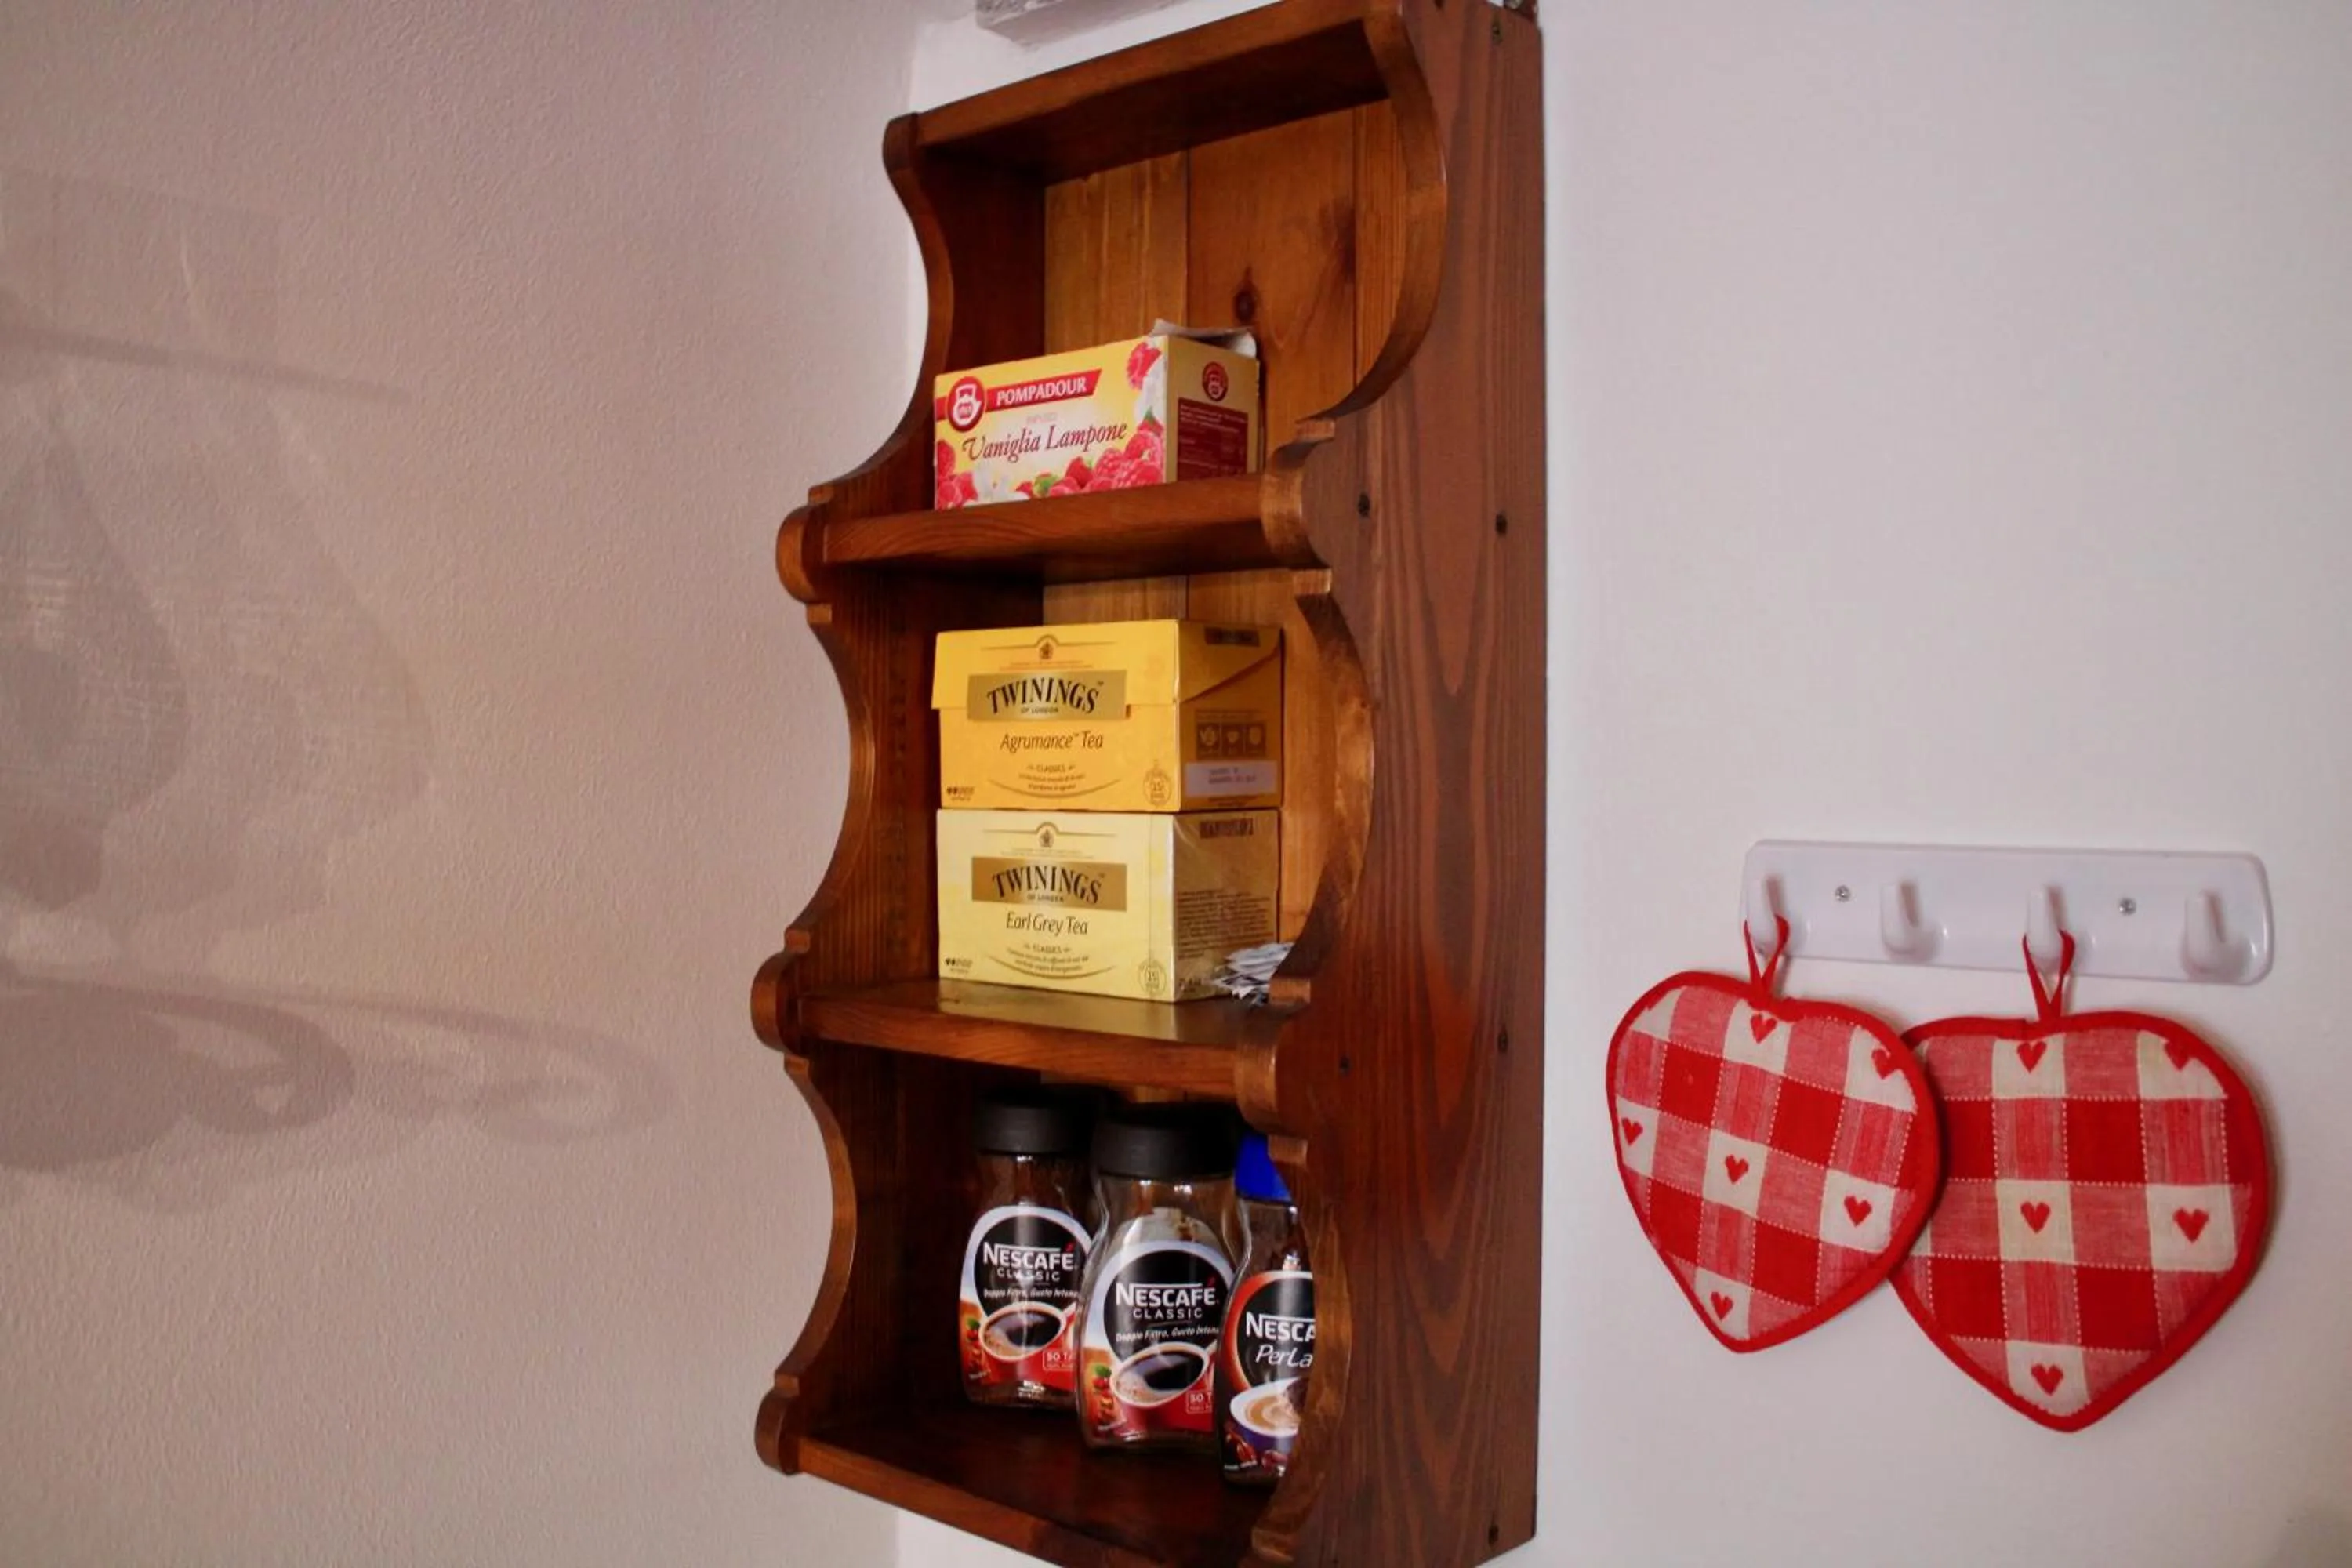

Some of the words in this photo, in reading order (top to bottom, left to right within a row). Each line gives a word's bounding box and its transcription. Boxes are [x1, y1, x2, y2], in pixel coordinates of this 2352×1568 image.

[996, 376, 1088, 406] POMPADOUR
[962, 427, 1040, 463] Vaniglia
[1045, 422, 1128, 452] Lampone
[986, 677, 1099, 715] TWININGS
[1082, 729, 1104, 750] Tea
[992, 865, 1102, 903] TWININGS
[1006, 911, 1032, 931] Earl
[1033, 913, 1064, 937] Grey
[1066, 916, 1089, 935] Tea
[1133, 1308, 1203, 1319] CLASSIC
